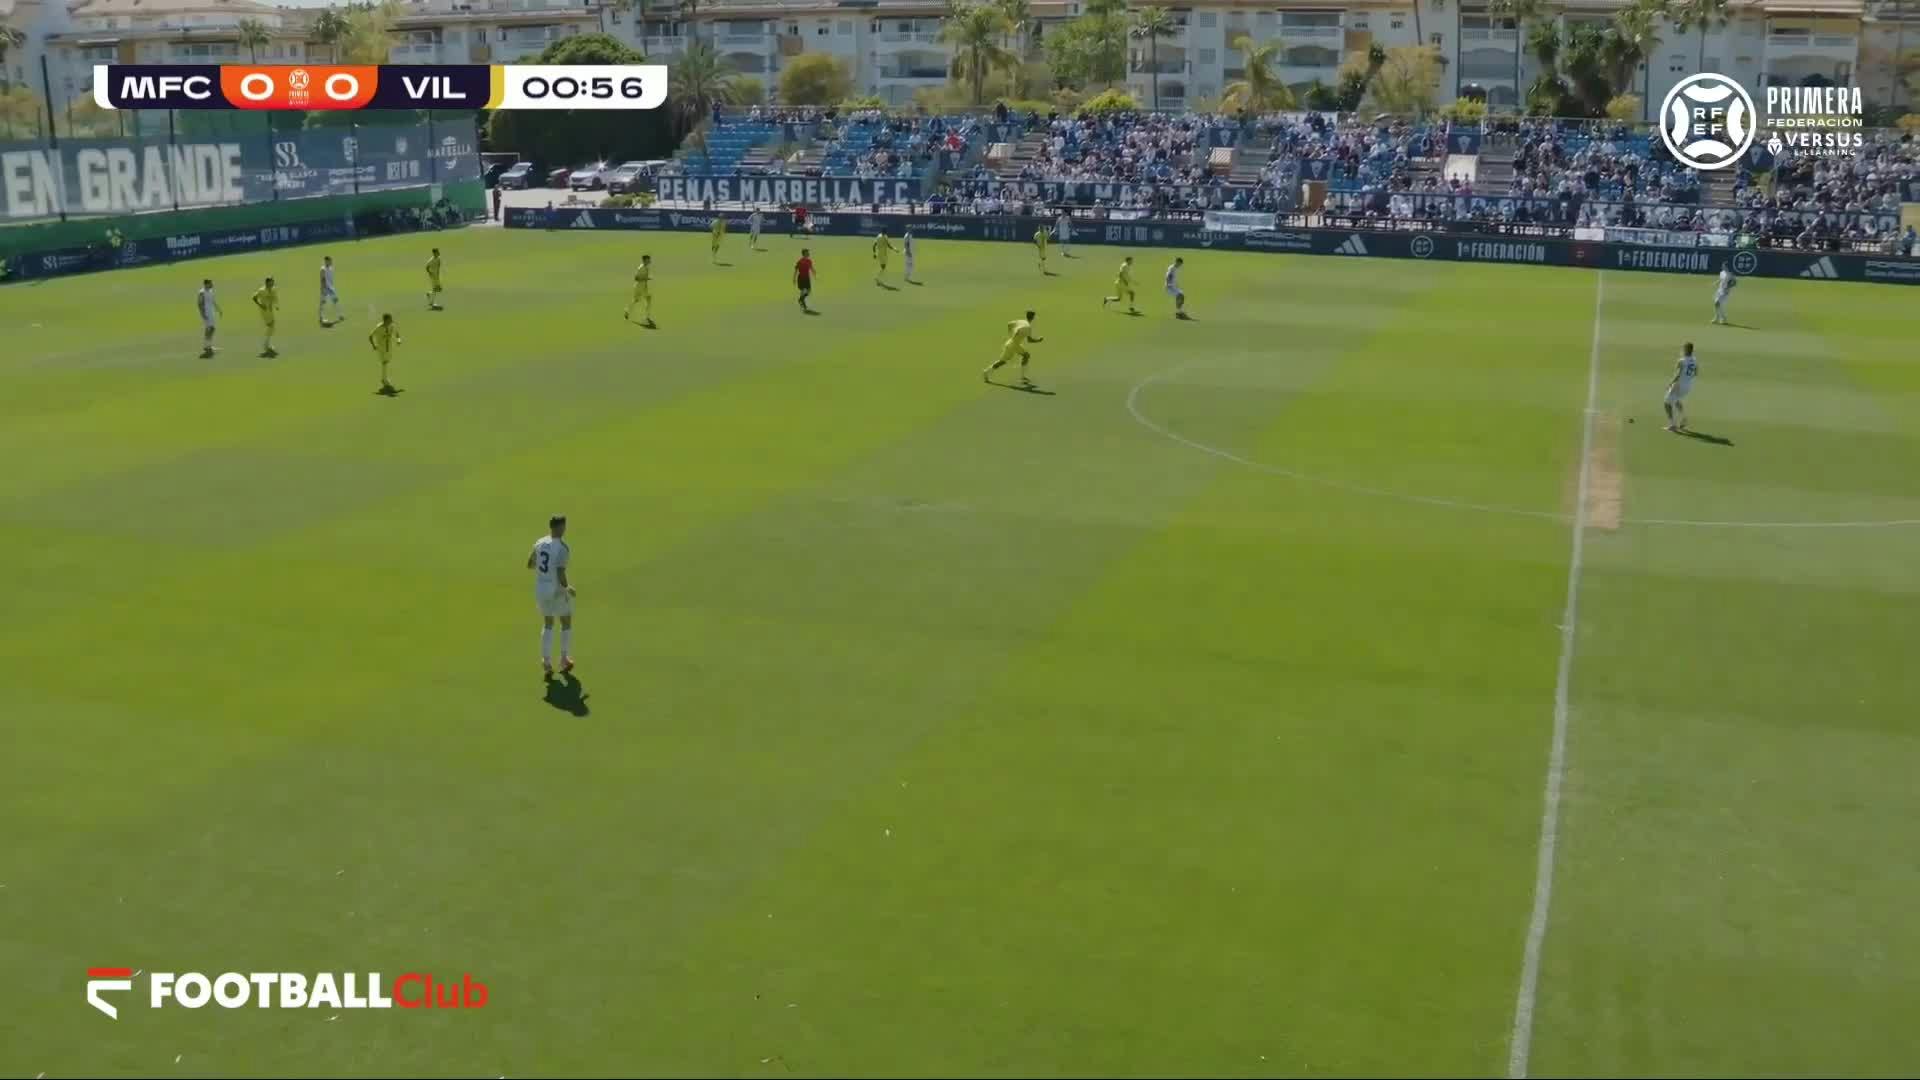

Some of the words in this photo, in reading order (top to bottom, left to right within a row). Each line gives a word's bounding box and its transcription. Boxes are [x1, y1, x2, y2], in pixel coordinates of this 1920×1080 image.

[2, 149, 67, 217] EN
[78, 143, 243, 210] GRANDE
[740, 179, 862, 203] MARBELLA
[1471, 242, 1545, 261] FEDERACIÓN
[1632, 250, 1710, 270] FEDERACIÓN
[539, 551, 550, 573] 3
